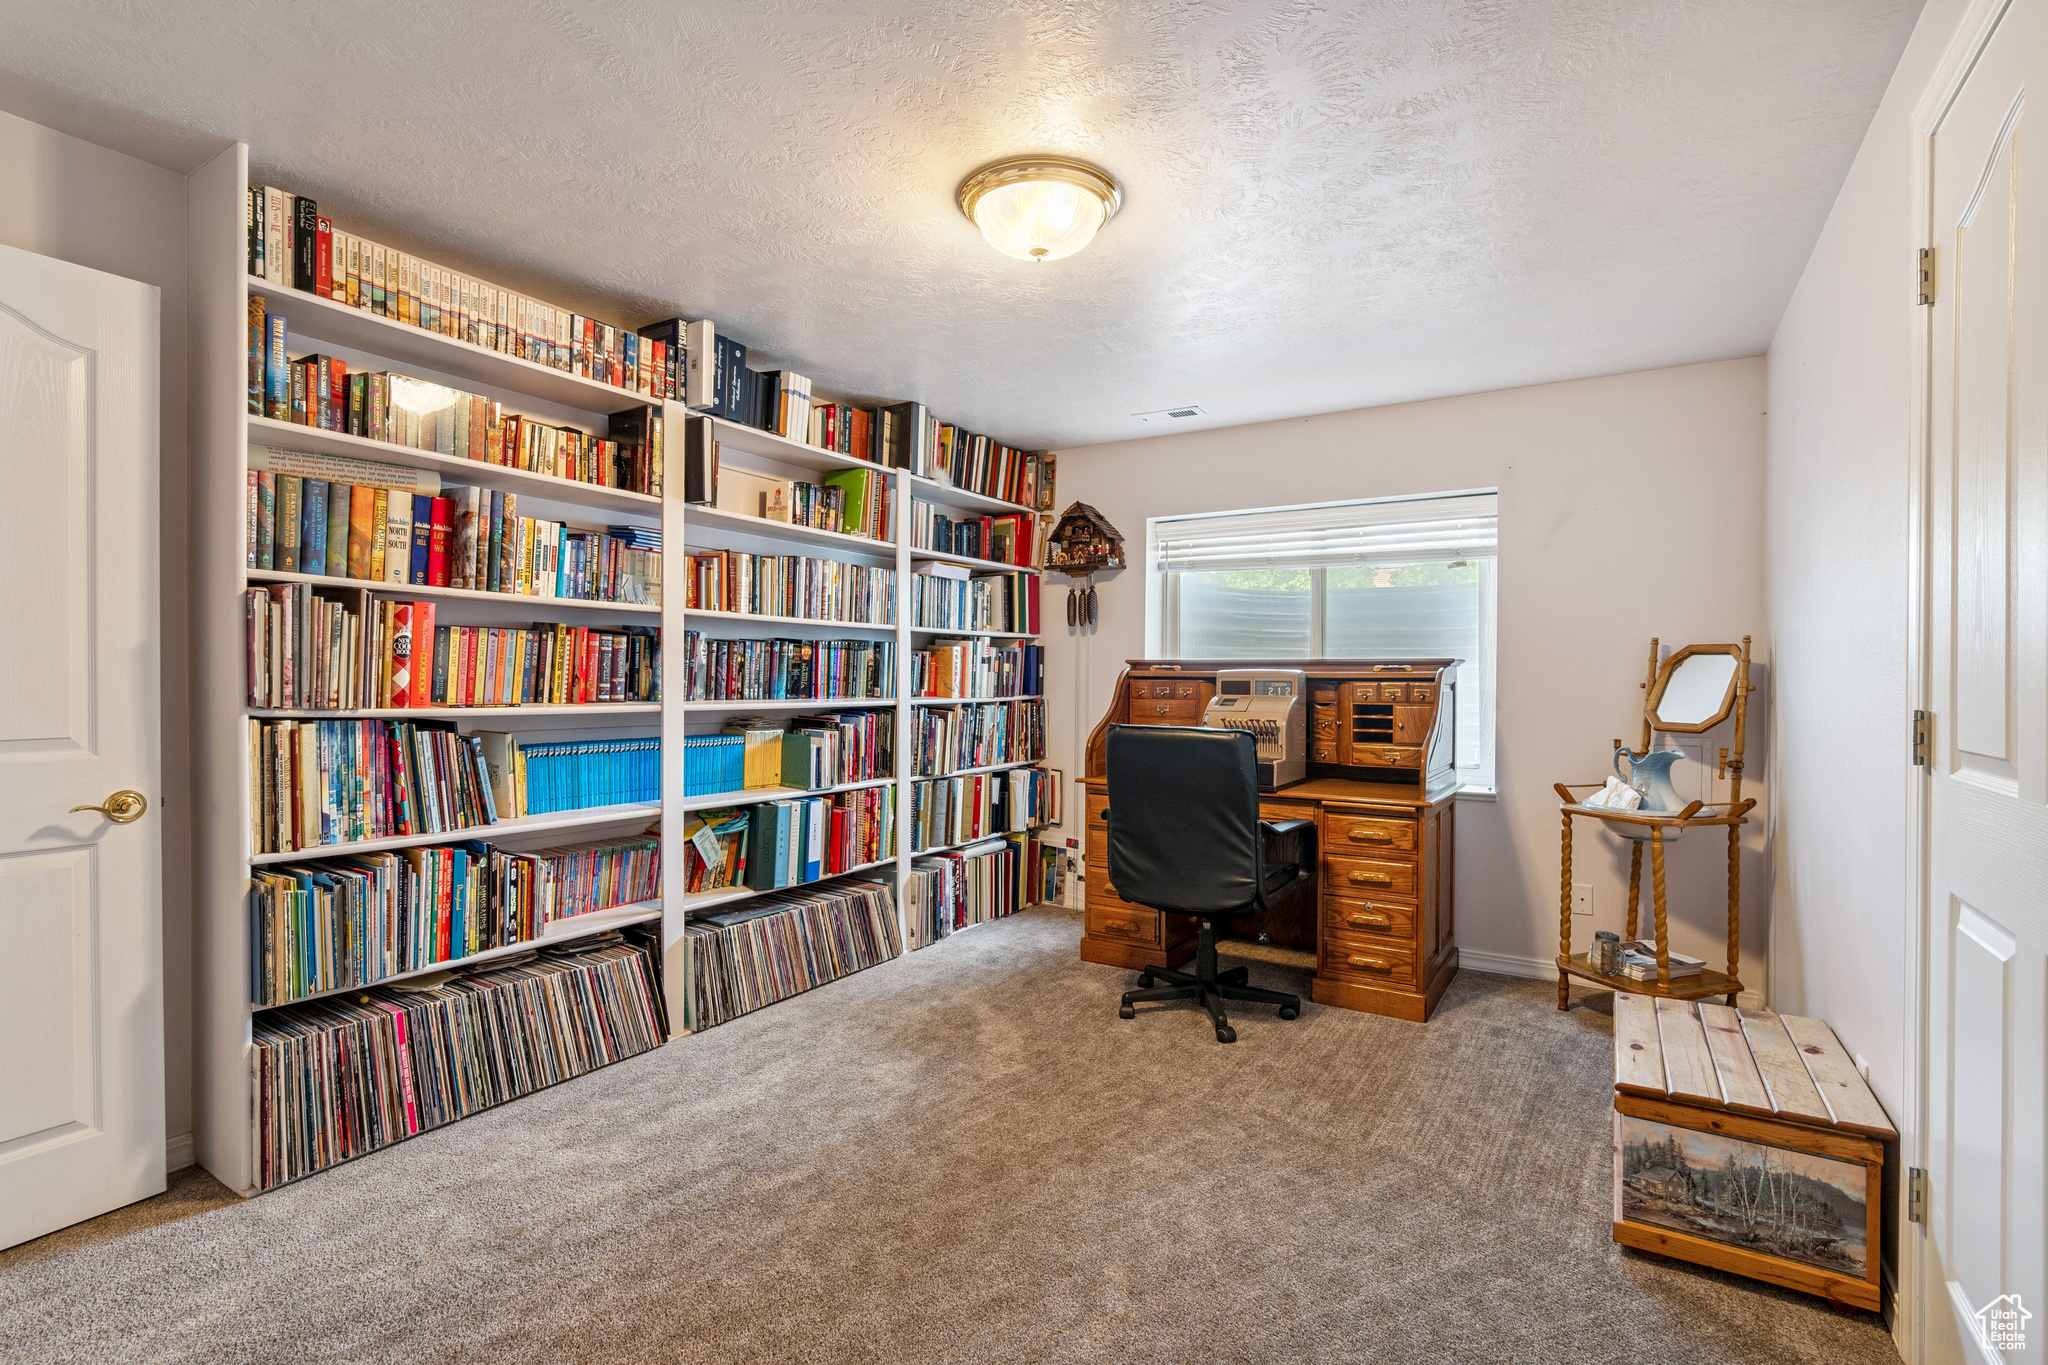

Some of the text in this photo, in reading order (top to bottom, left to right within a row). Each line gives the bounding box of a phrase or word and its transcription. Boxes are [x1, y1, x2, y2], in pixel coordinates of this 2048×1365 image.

[306, 200, 316, 231] ELVIS
[678, 320, 686, 346] SAINTS
[273, 318, 284, 397] NORA ROBERTS HIDEAWAY
[388, 540, 406, 550] SOUTH
[389, 527, 407, 536] NORTH
[419, 652, 427, 694] COOKBOOK
[758, 828, 770, 864] Logan
[455, 884, 463, 912] Disneyland
